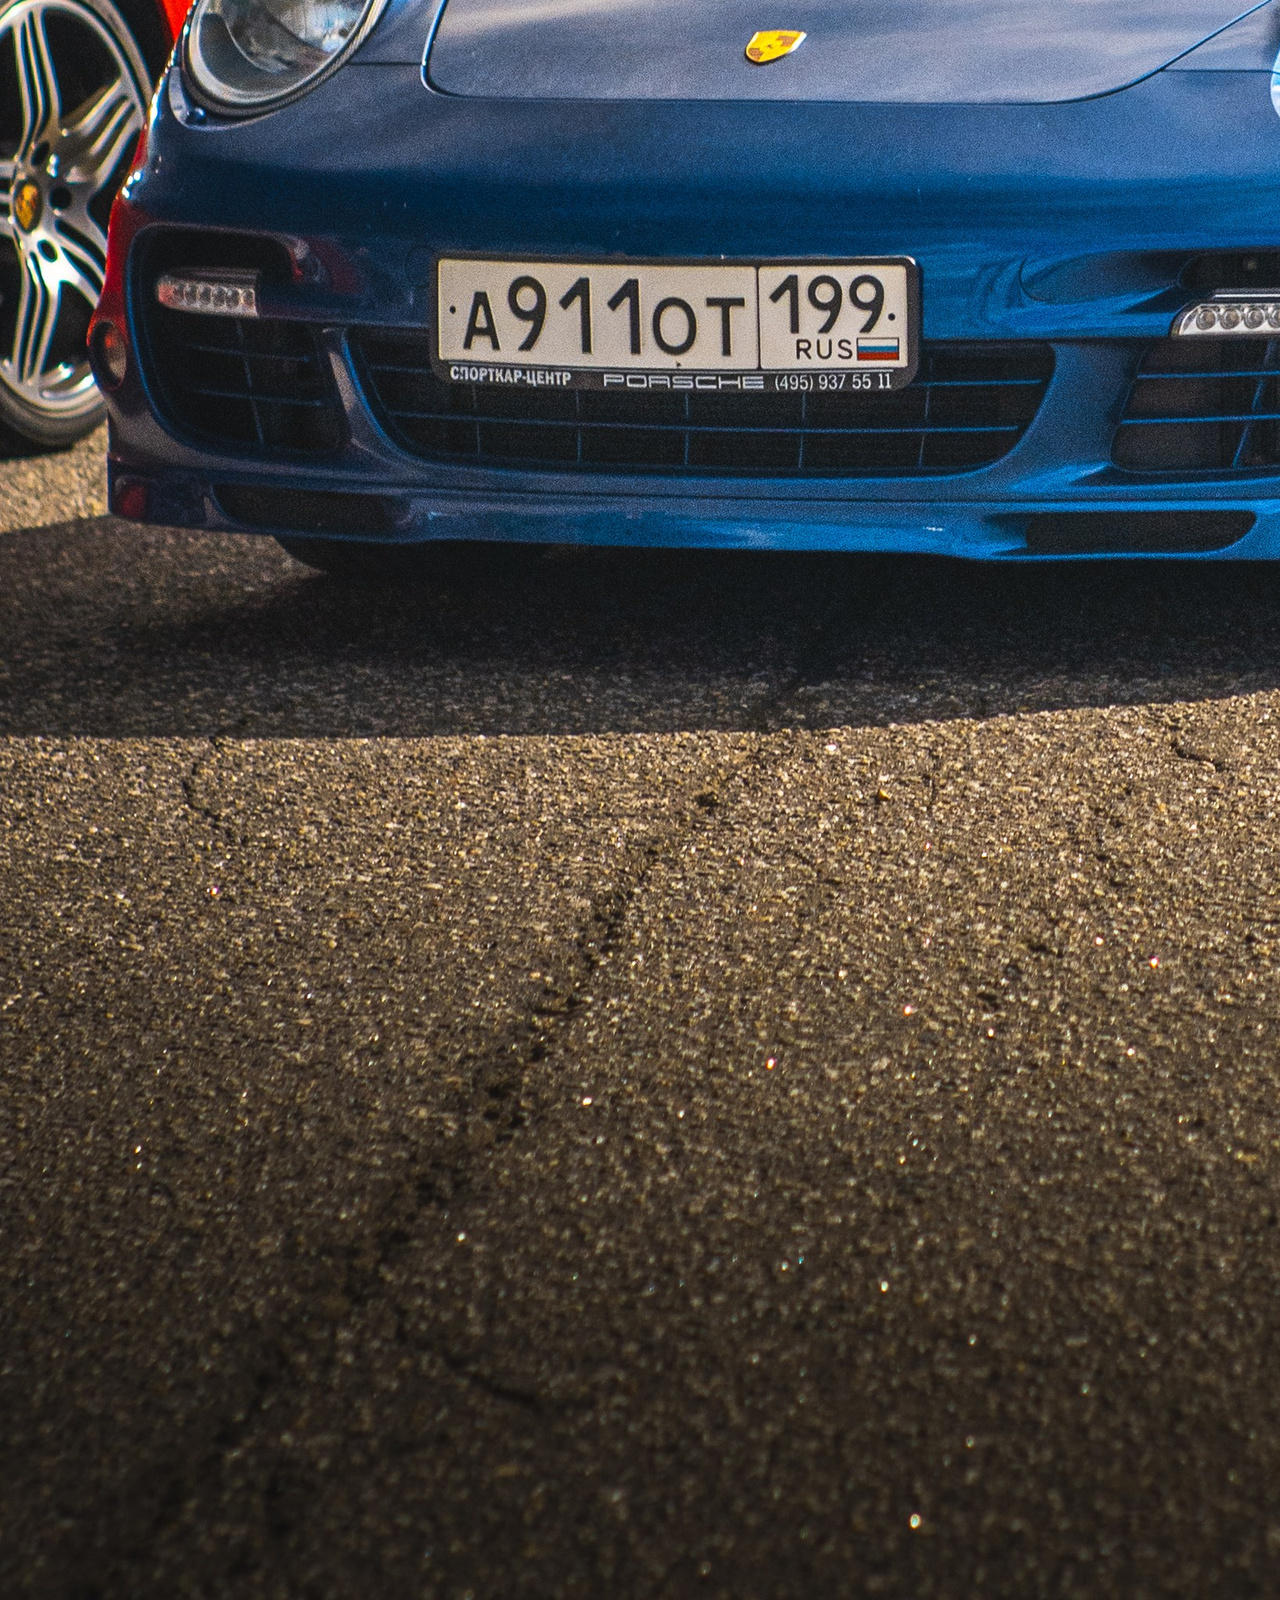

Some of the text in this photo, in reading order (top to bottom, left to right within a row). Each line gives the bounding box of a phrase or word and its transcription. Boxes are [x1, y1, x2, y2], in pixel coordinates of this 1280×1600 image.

[769, 274, 886, 334] 199
[795, 339, 853, 361] RUS
[450, 365, 572, 387] СПОРТКАР-ЦЕНТР
[603, 372, 892, 391] PORSCHE (495) 937 55 11
